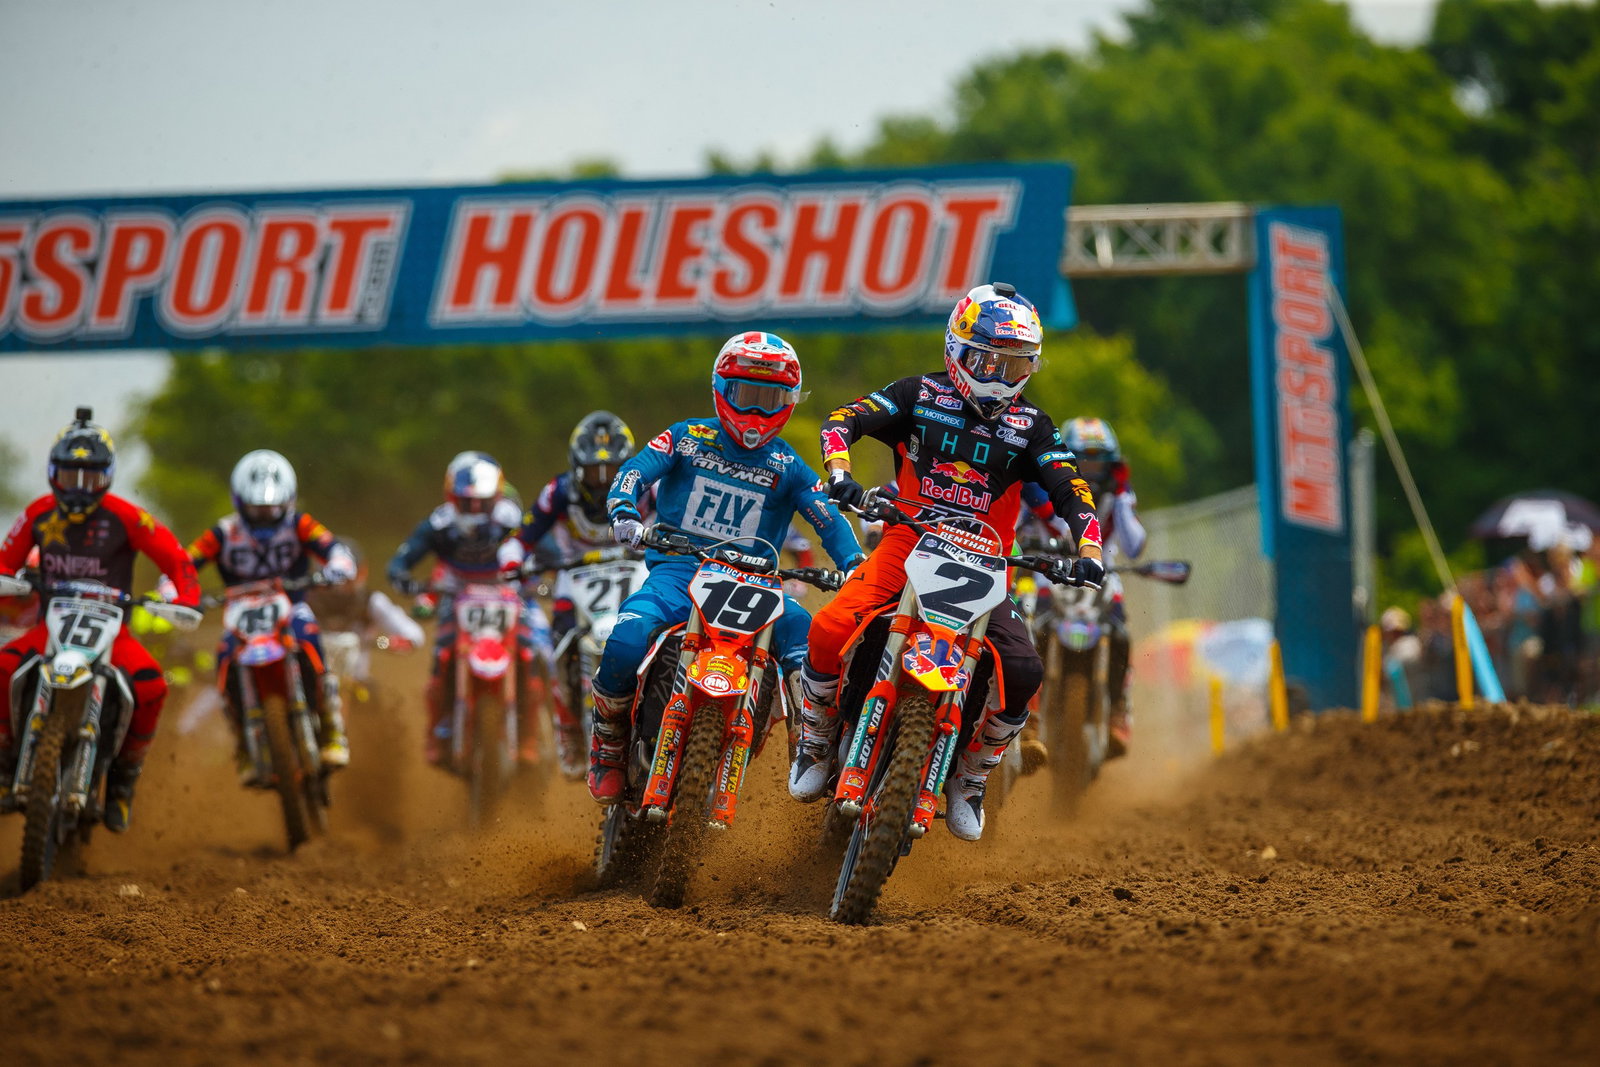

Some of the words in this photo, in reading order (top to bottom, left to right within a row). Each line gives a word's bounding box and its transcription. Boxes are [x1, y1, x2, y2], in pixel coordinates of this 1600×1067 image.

[440, 190, 1012, 318] HOLESHOT
[0, 209, 402, 328] SPORT
[995, 328, 1017, 336] Red
[1017, 330, 1036, 339] Bull
[949, 362, 972, 398] Bull
[939, 396, 960, 408] 100%
[924, 409, 960, 426] MOTOREX
[1006, 416, 1028, 427] BELL
[705, 452, 730, 466] ROCKY
[732, 461, 775, 478] MOUNTAIN
[695, 486, 757, 529] FLY
[921, 476, 958, 503] Red
[957, 485, 992, 513] Bull
[692, 518, 741, 538] RACING
[941, 524, 995, 546] RENTHAL
[939, 532, 994, 554] RENTHAL
[968, 555, 983, 566] OIL
[748, 575, 763, 584] OIL
[919, 561, 995, 622] 2
[587, 577, 631, 612] 21
[700, 580, 781, 632] 19
[59, 613, 108, 648] 15
[934, 616, 960, 628] MOTOREX
[706, 677, 728, 690] RM
[847, 714, 867, 764] MOTOREX
[940, 732, 959, 783] MOTOREX
